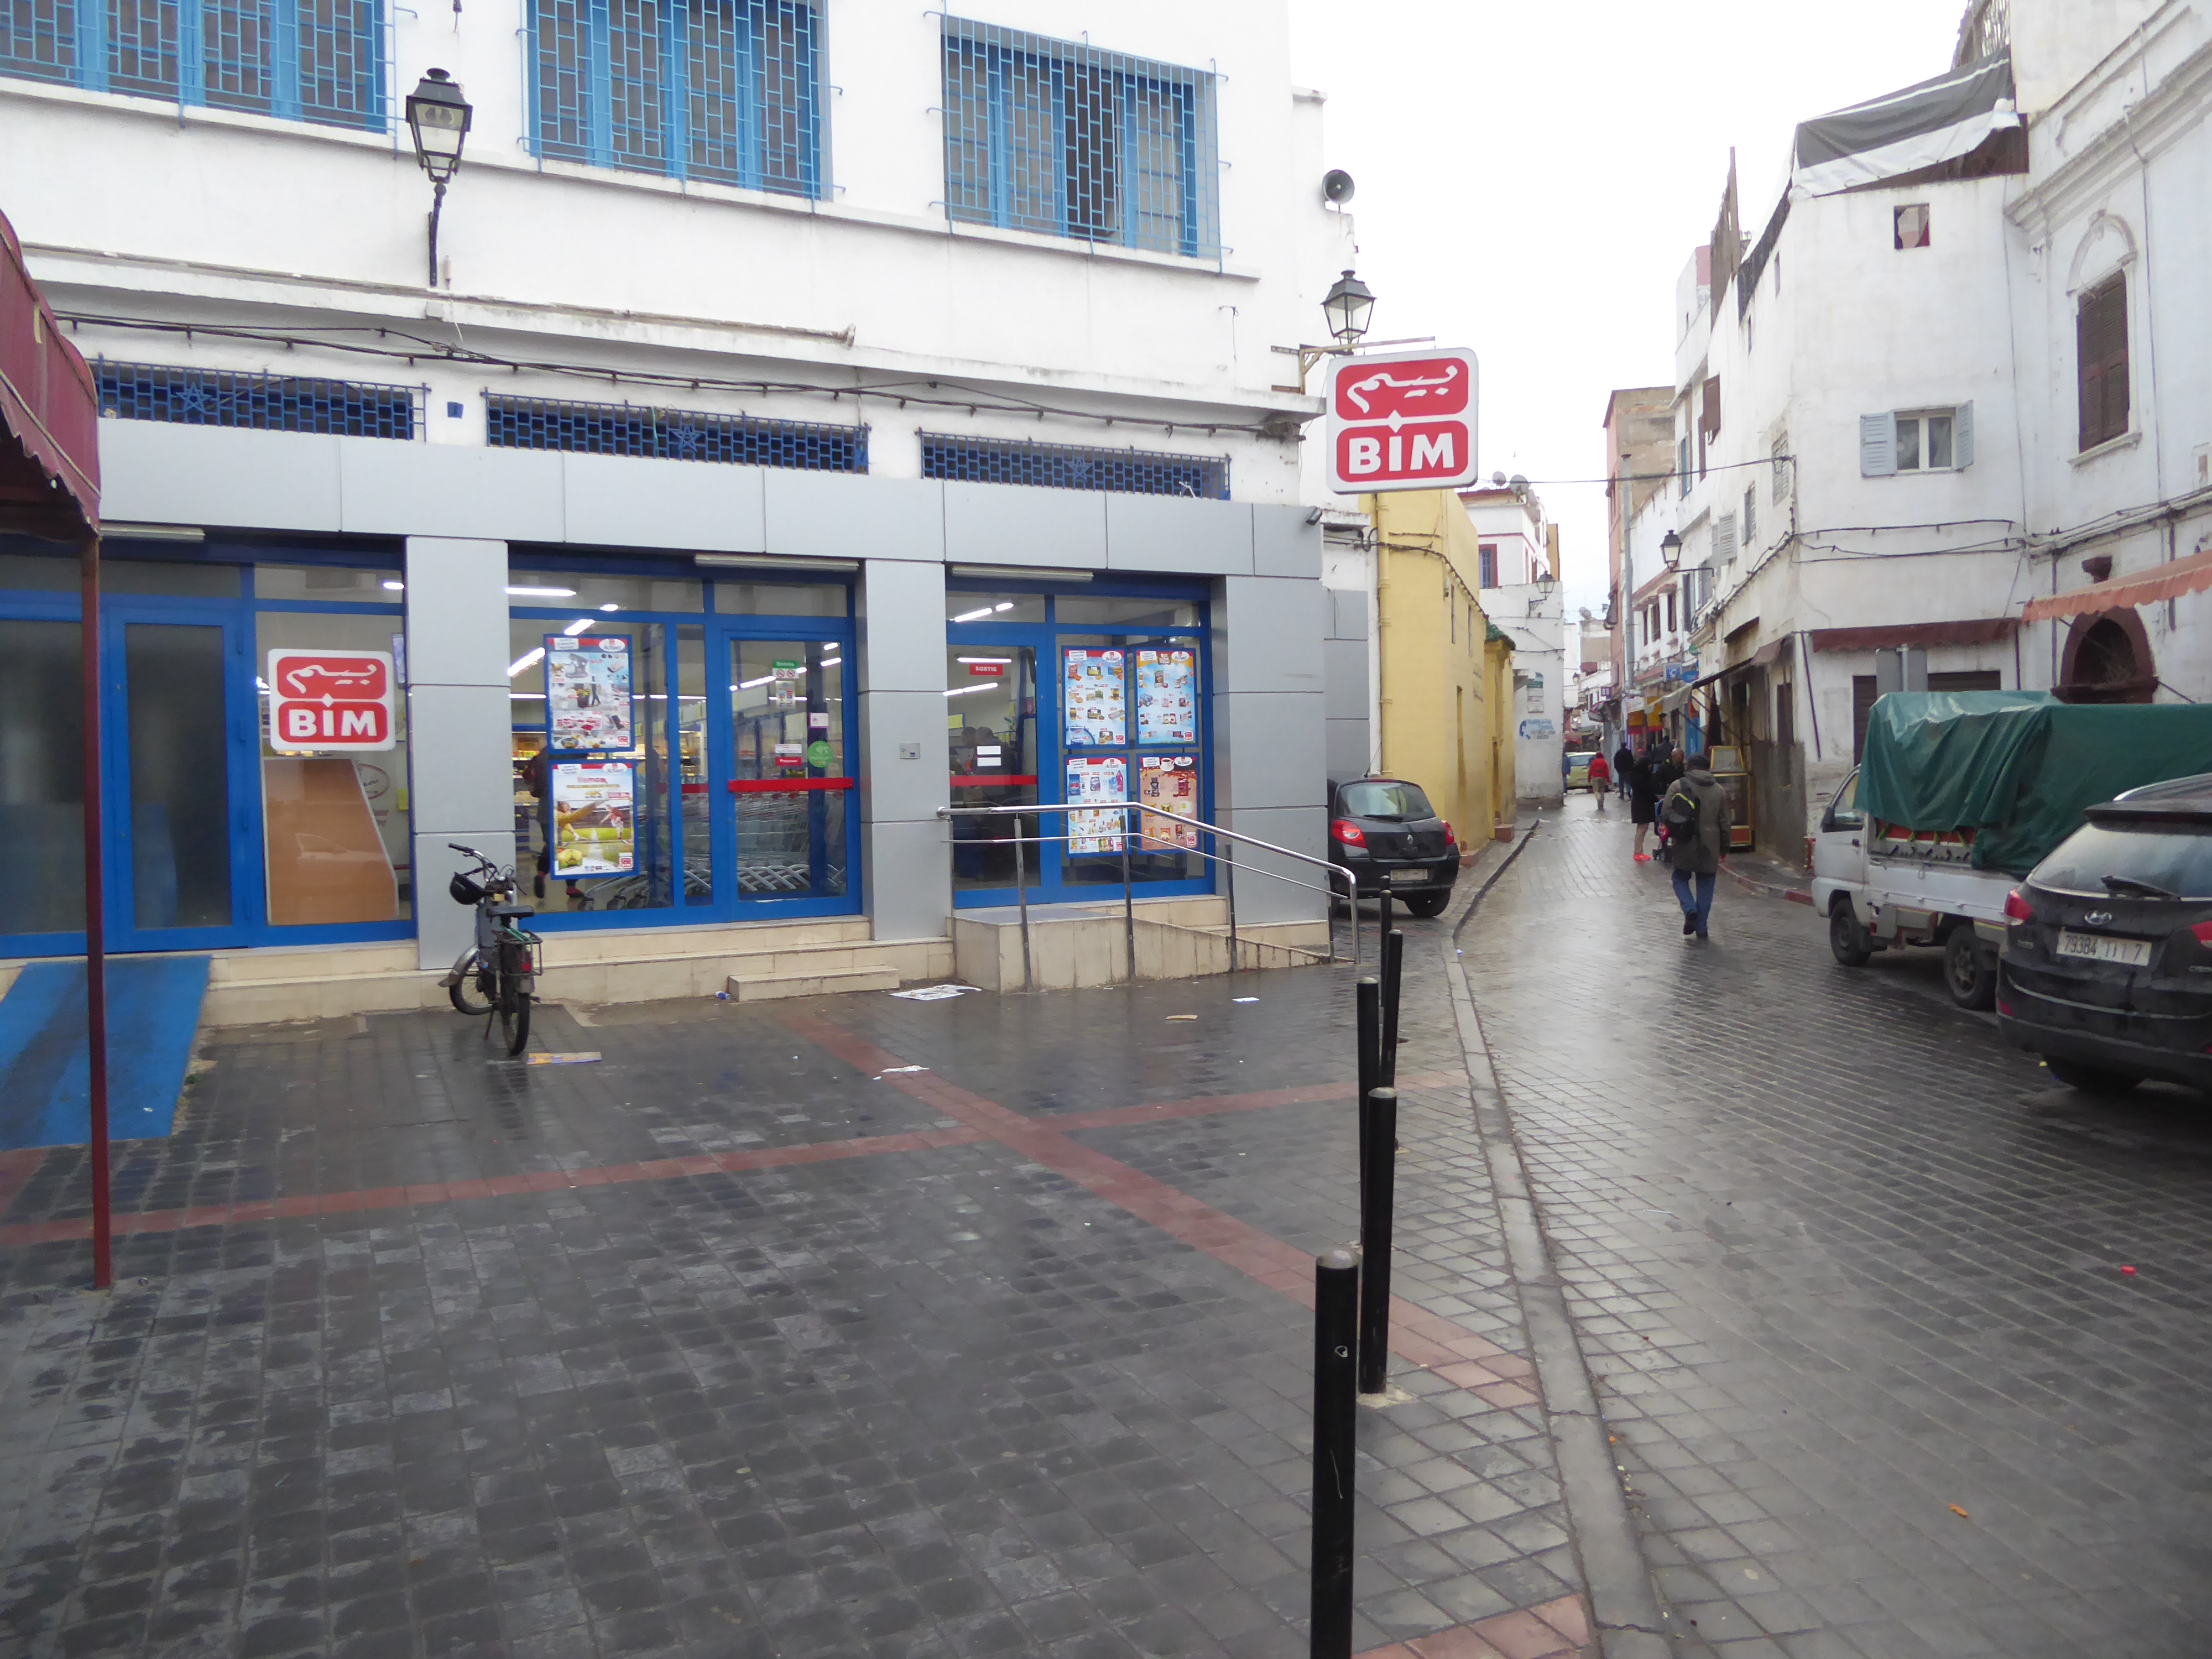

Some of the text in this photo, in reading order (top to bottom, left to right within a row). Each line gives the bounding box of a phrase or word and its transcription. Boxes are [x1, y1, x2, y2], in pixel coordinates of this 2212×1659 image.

[1347, 365, 1458, 414] بيم
[1349, 432, 1455, 474] BIM
[286, 664, 377, 694] بيم
[289, 709, 377, 737] BIM
